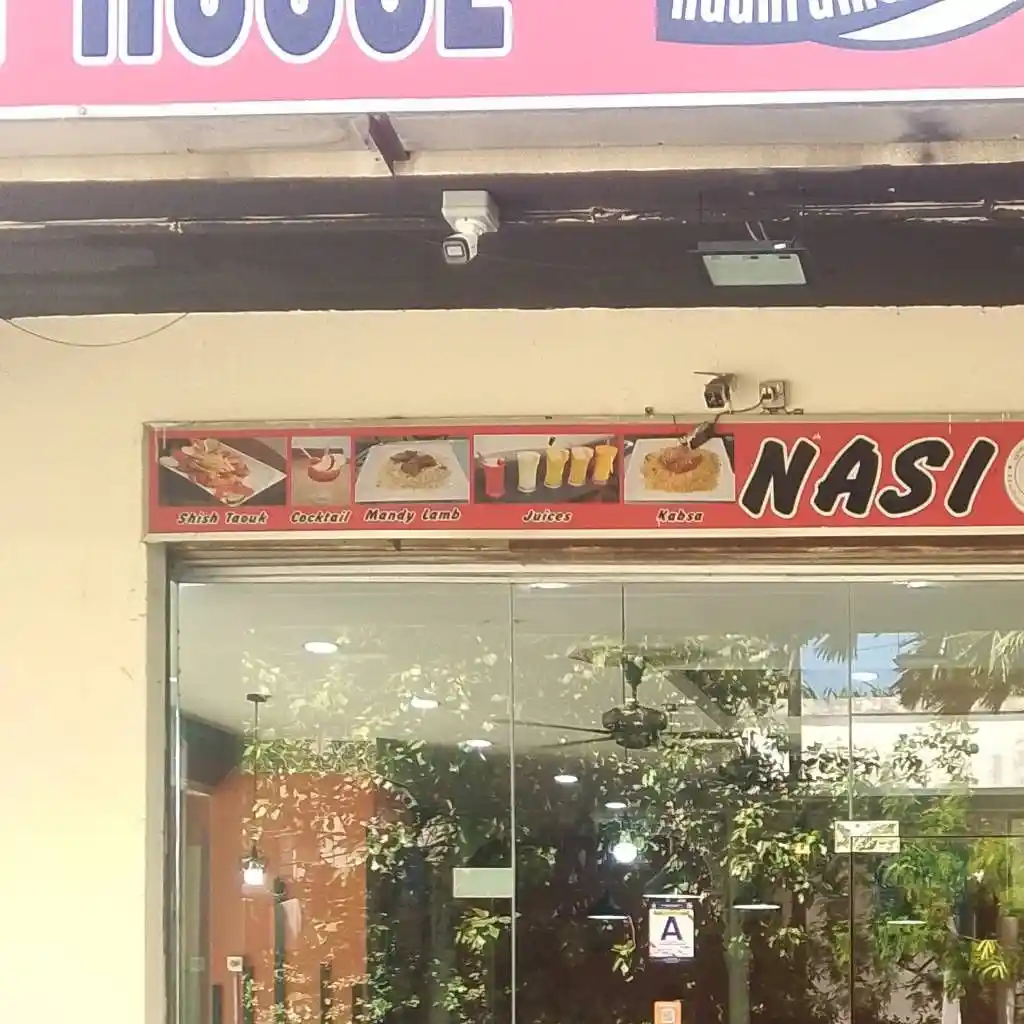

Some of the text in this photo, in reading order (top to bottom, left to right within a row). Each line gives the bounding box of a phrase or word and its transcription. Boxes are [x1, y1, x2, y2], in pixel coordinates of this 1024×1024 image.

[739, 435, 998, 519] NASI
[178, 511, 268, 524] Shish Taouk
[290, 510, 351, 523] Cocktail
[365, 507, 461, 524] Mandy Lamb
[523, 508, 573, 522] Juices
[657, 509, 704, 522] Kabsa
[660, 916, 683, 941] A
